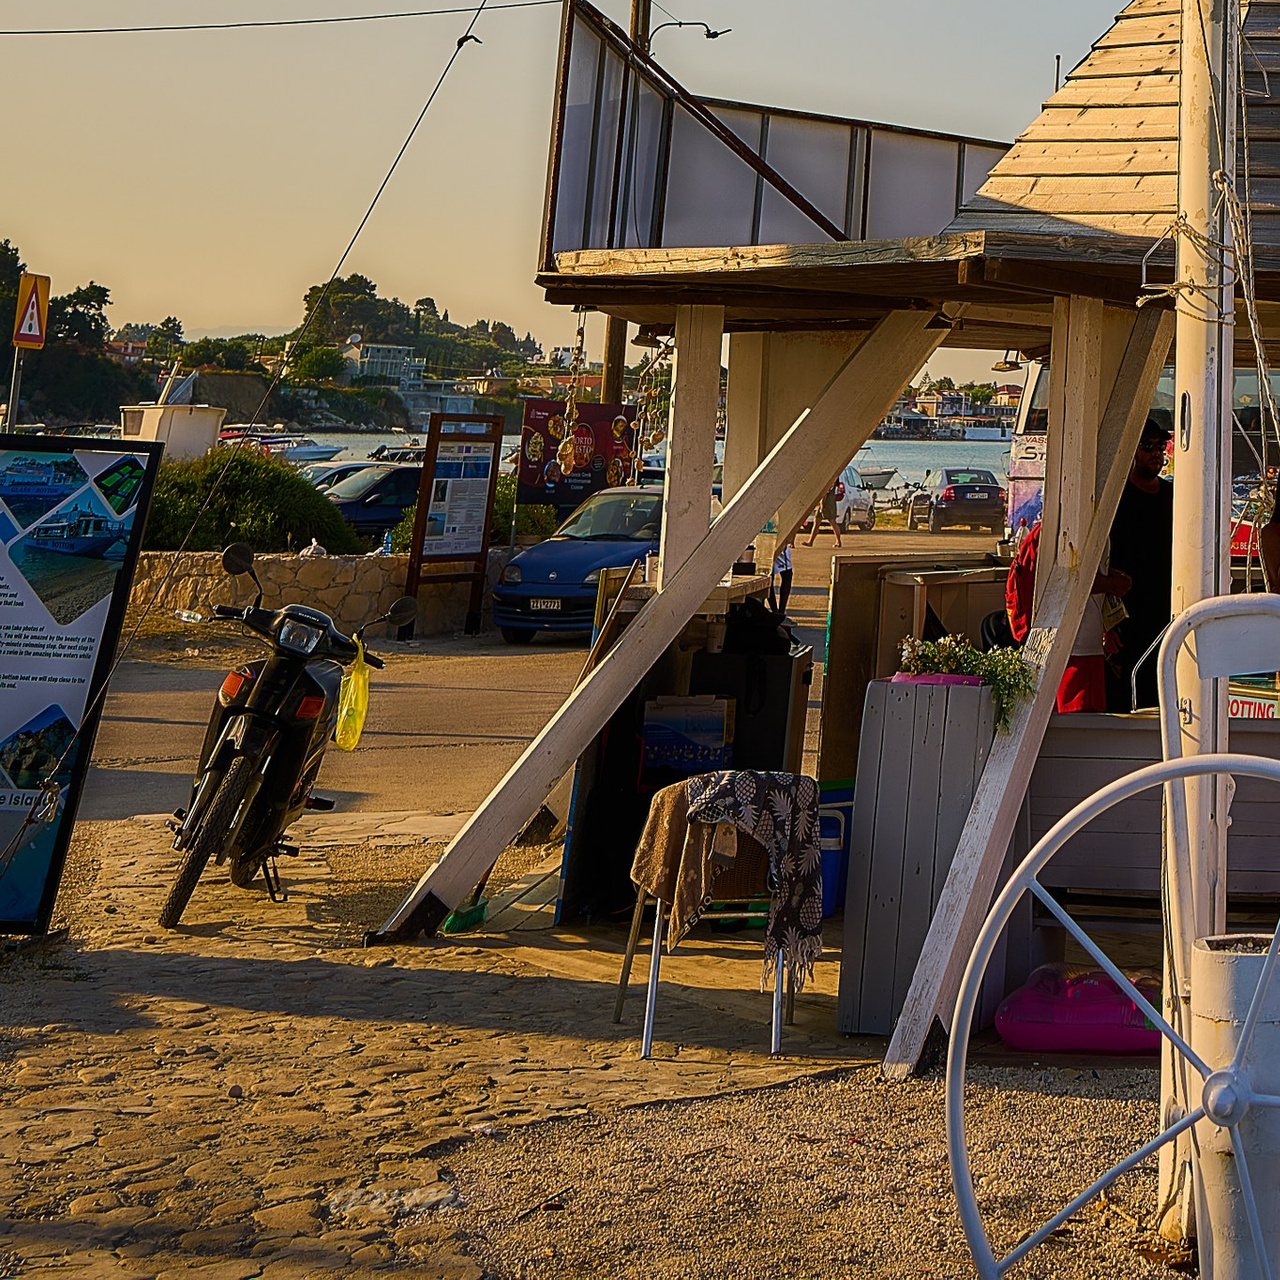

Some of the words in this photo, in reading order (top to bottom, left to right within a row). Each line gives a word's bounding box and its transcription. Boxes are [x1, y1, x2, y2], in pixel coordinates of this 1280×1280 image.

[574, 436, 592, 445] ORTO
[575, 445, 592, 453] ESTO
[1229, 698, 1275, 719] OTTING
[9, 793, 50, 807] Isla
